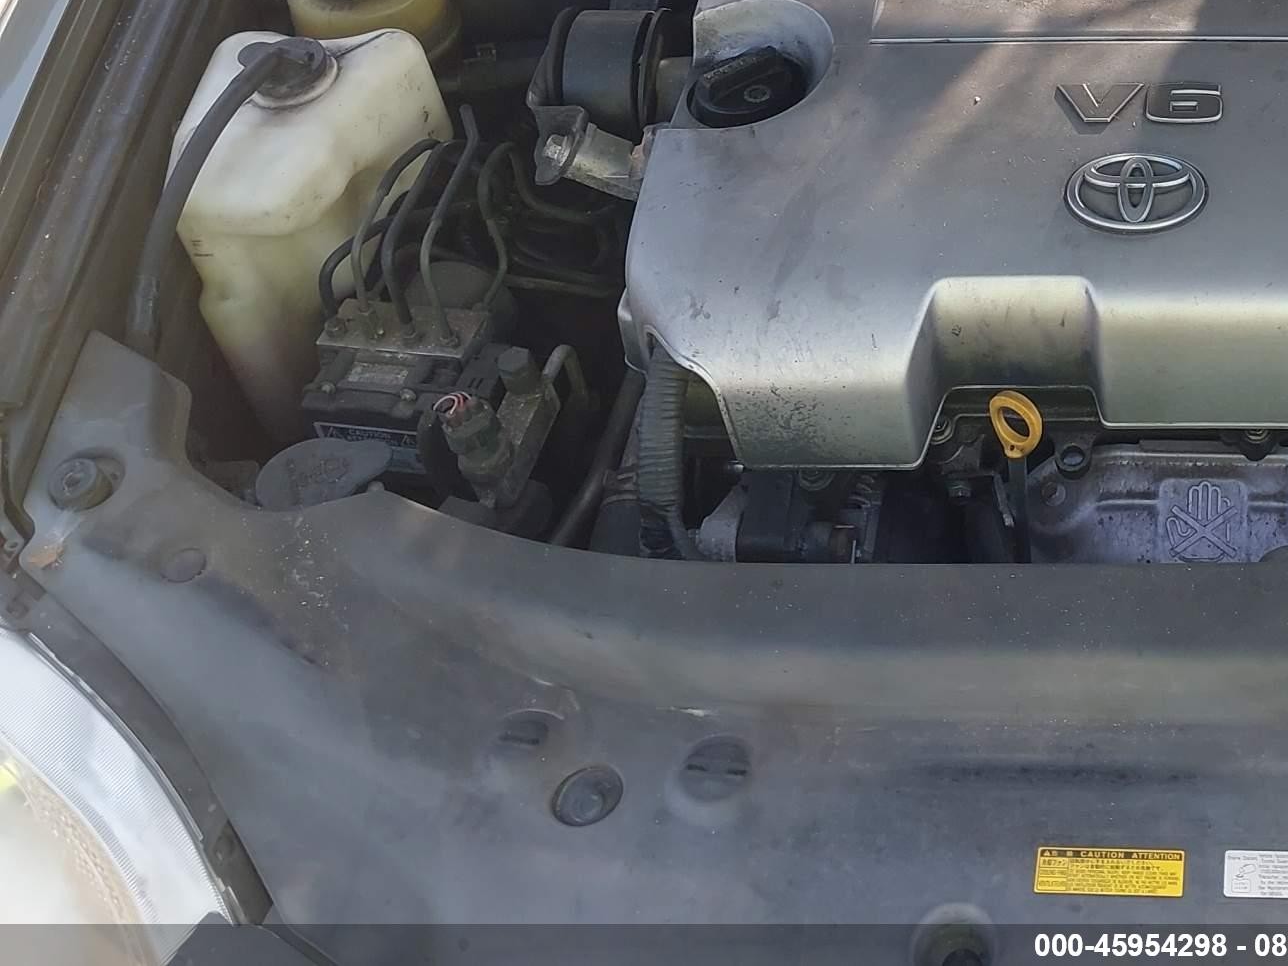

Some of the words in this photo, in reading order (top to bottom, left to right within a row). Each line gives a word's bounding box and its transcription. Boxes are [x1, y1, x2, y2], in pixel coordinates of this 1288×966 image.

[1054, 81, 1224, 124] V6
[1080, 851, 1124, 859] CAUTION
[1131, 852, 1181, 860] ATTENTION
